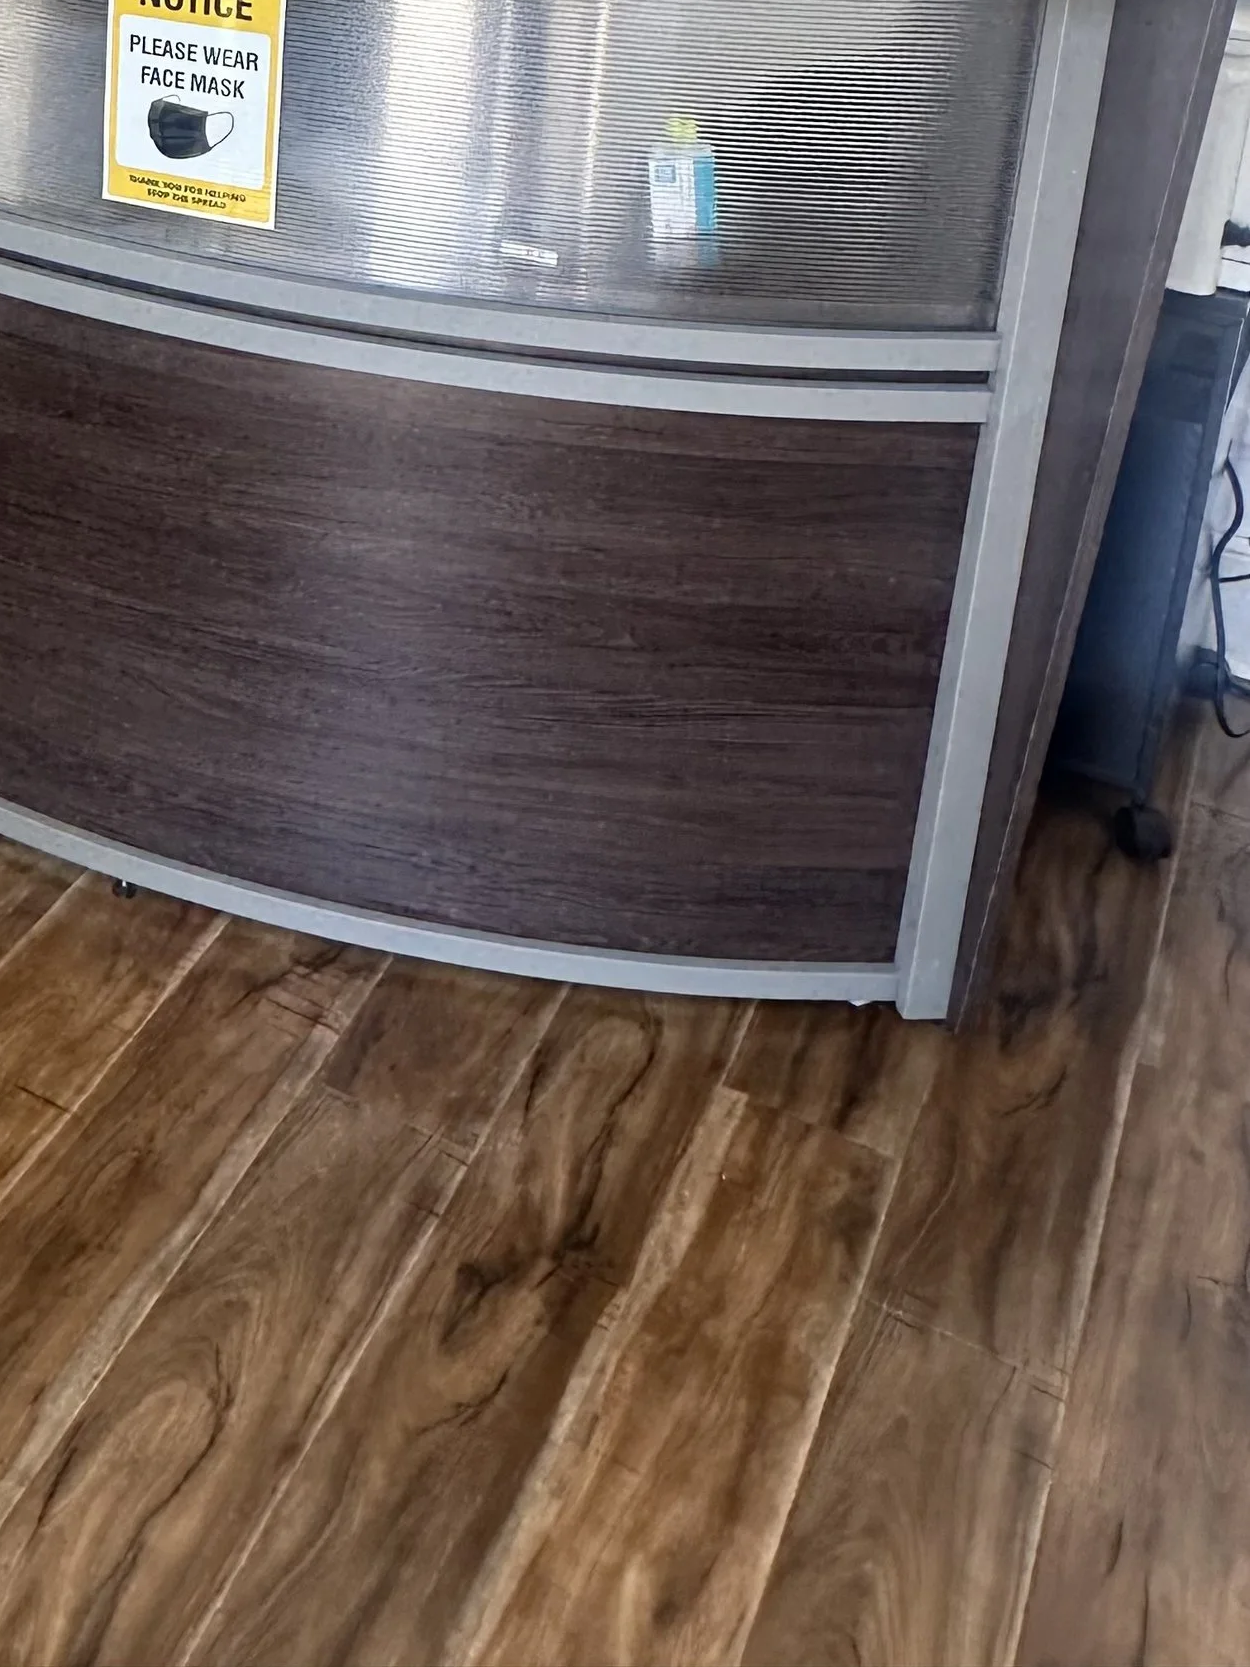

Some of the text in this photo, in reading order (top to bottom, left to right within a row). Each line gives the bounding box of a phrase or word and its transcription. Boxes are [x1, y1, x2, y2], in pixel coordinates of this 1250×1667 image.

[129, 34, 259, 72] PLEASE WEAR
[141, 65, 246, 100] FACE MASK
[129, 174, 161, 188] THANK
[162, 180, 182, 192] YOU
[183, 184, 203, 196] FOR
[147, 188, 170, 199] STOP
[191, 196, 227, 210] SPREAD
